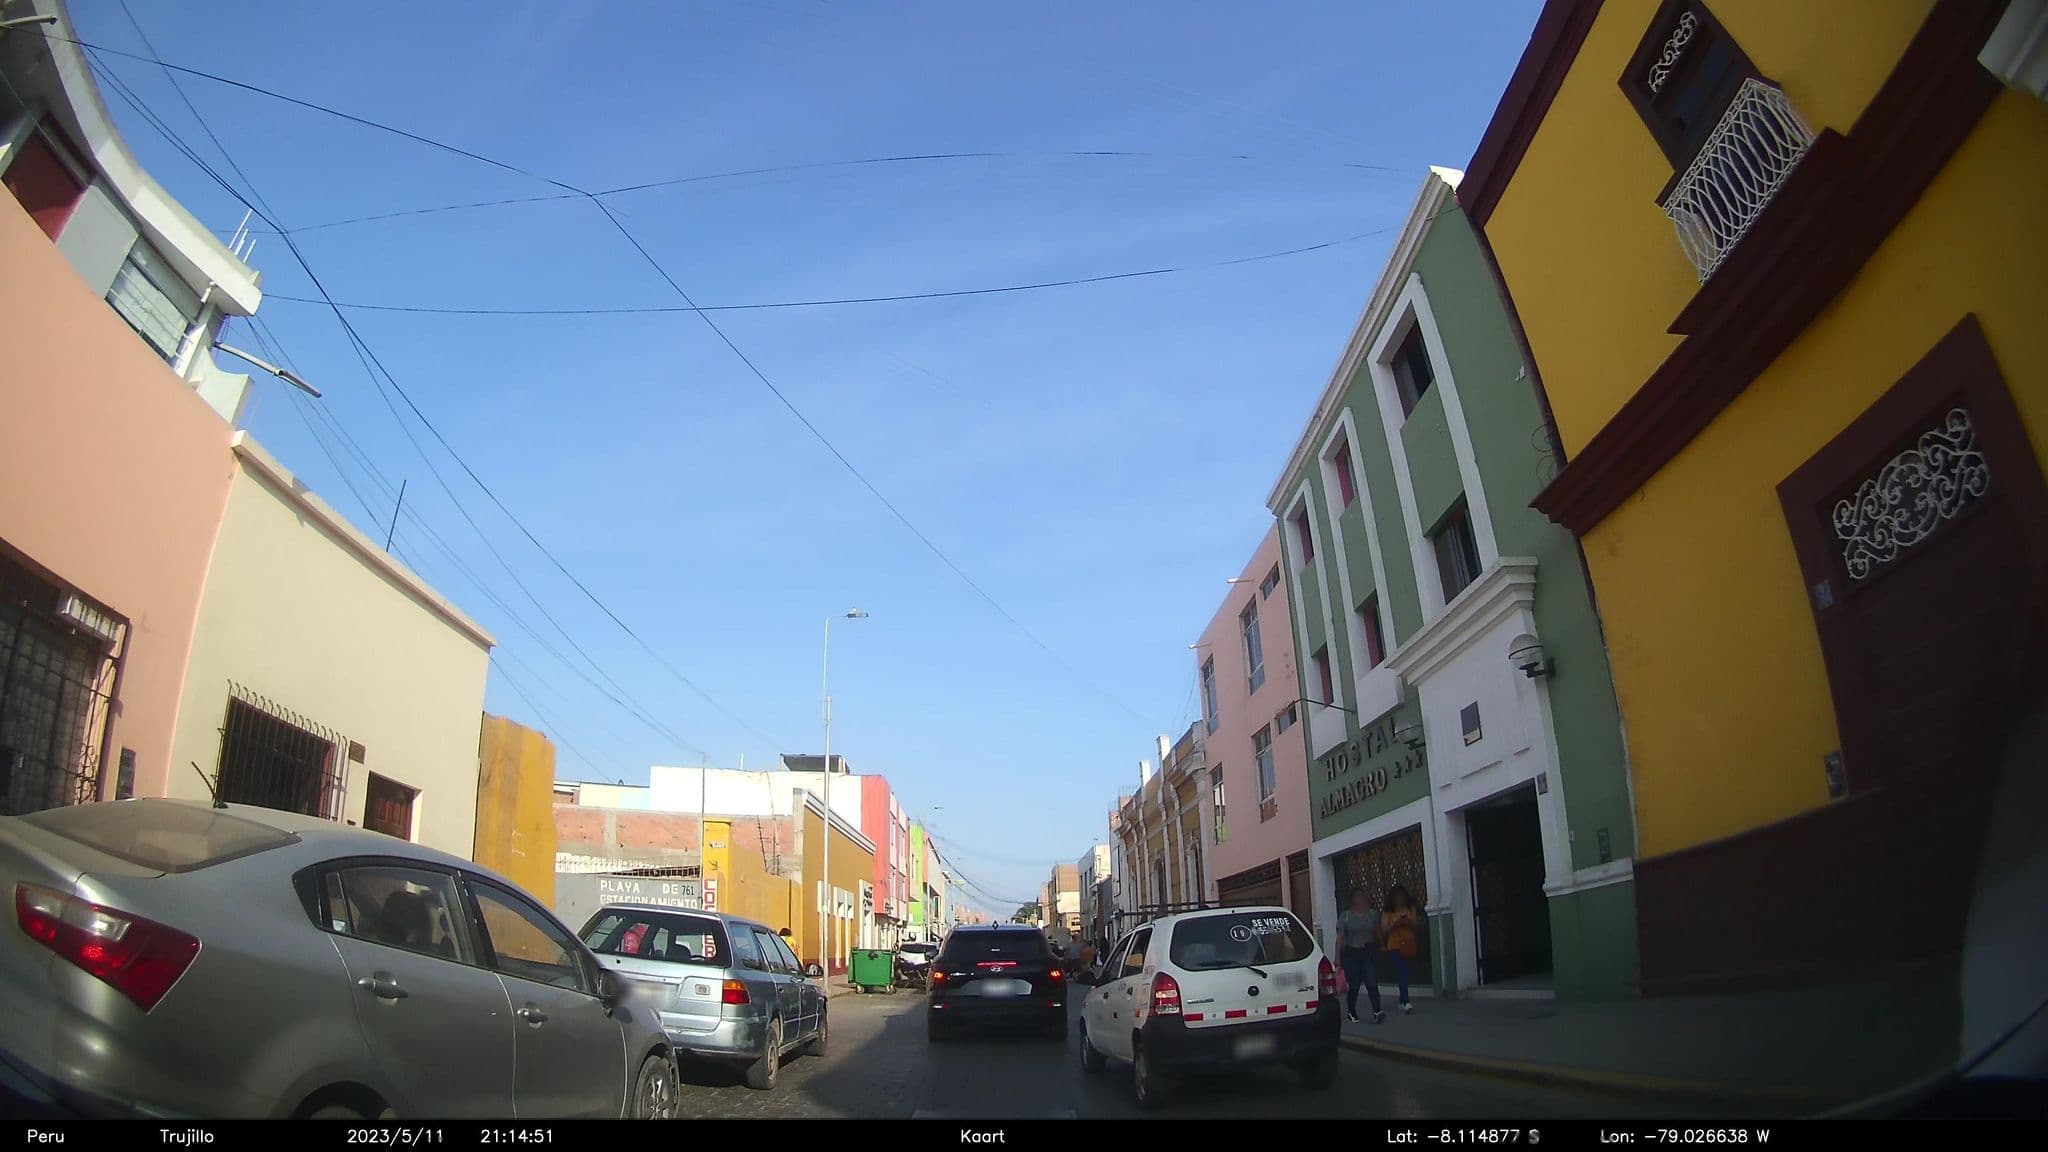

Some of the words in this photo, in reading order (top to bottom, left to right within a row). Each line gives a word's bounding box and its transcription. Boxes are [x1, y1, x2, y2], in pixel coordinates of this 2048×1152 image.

[1325, 717, 1399, 782] HOSTAL
[1320, 768, 1388, 819] ALMAGRO
[600, 880, 640, 893] PLAYA
[662, 883, 679, 895] DE
[682, 885, 694, 895] 761
[1251, 919, 1263, 927] SE
[1264, 917, 1290, 927] VENDE
